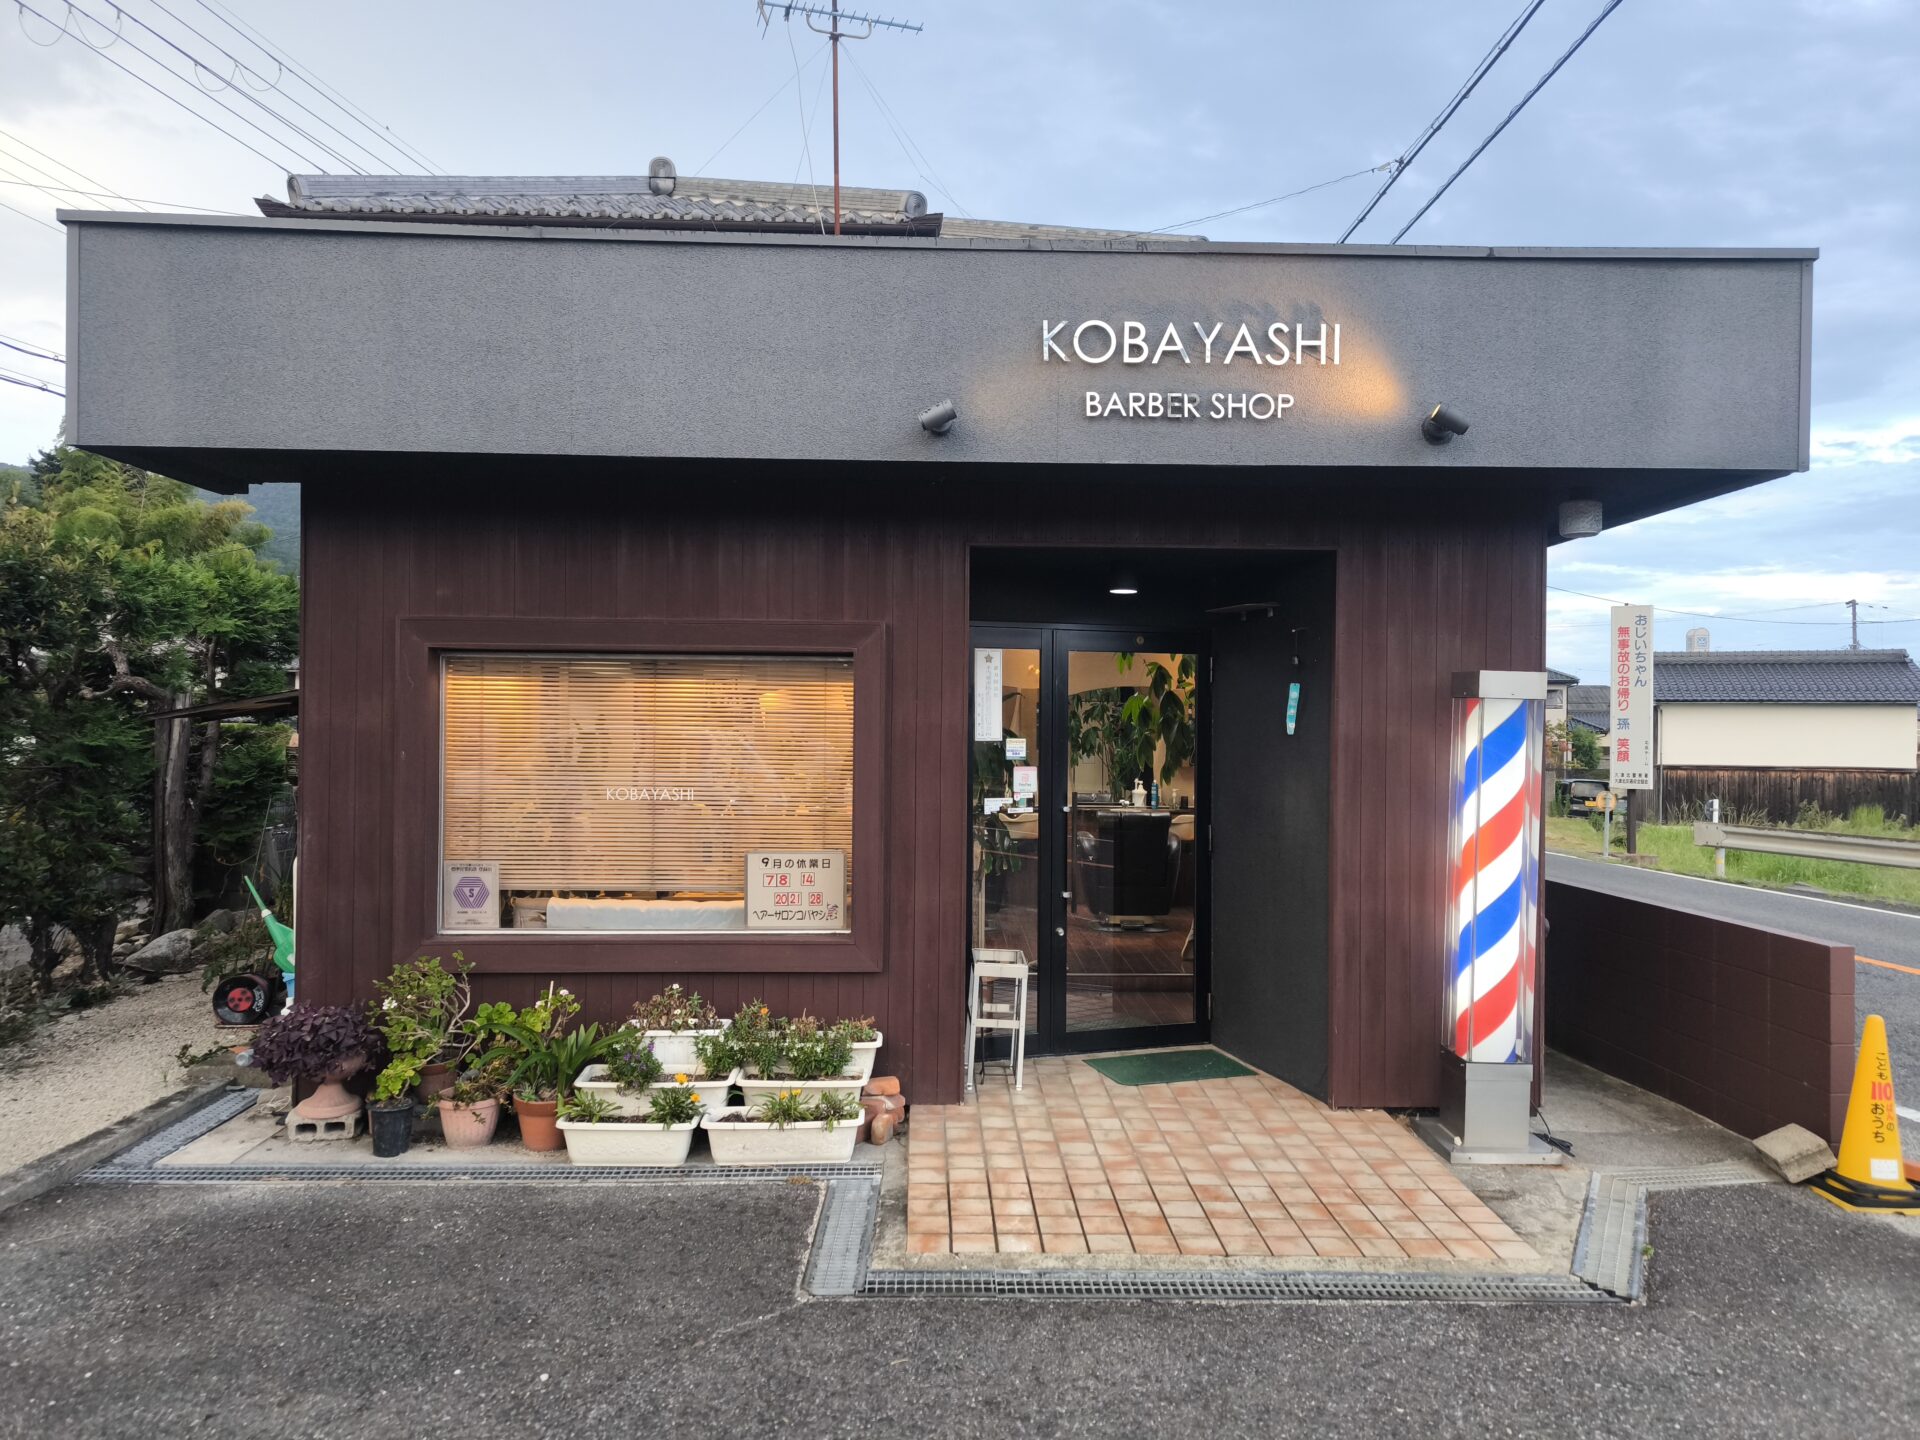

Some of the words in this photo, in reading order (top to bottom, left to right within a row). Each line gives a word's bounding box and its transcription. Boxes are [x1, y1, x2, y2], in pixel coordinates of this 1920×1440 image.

[1042, 319, 1341, 366] KOBAYASHI
[1085, 391, 1201, 418] BARBER
[1210, 393, 1295, 420] SHOP
[1634, 614, 1647, 687] おじいちゃん
[1617, 625, 1630, 711] 無事故のお帰り
[1617, 718, 1630, 730] 孫
[1617, 738, 1630, 762] 笑顔
[606, 787, 694, 801] KOBAYASHI
[761, 857, 831, 869] 9月の休業日
[766, 875, 774, 885] 7
[779, 875, 788, 885] 8
[802, 874, 814, 885] 14
[468, 888, 475, 898] S
[775, 894, 787, 905] 20
[790, 894, 800, 904] 21
[810, 893, 821, 905] 28
[752, 909, 826, 921] ヘアーサロンコバヤシ
[1876, 1052, 1888, 1080] こども
[1871, 1081, 1892, 1101] 110
[1871, 1103, 1886, 1143] おうち
